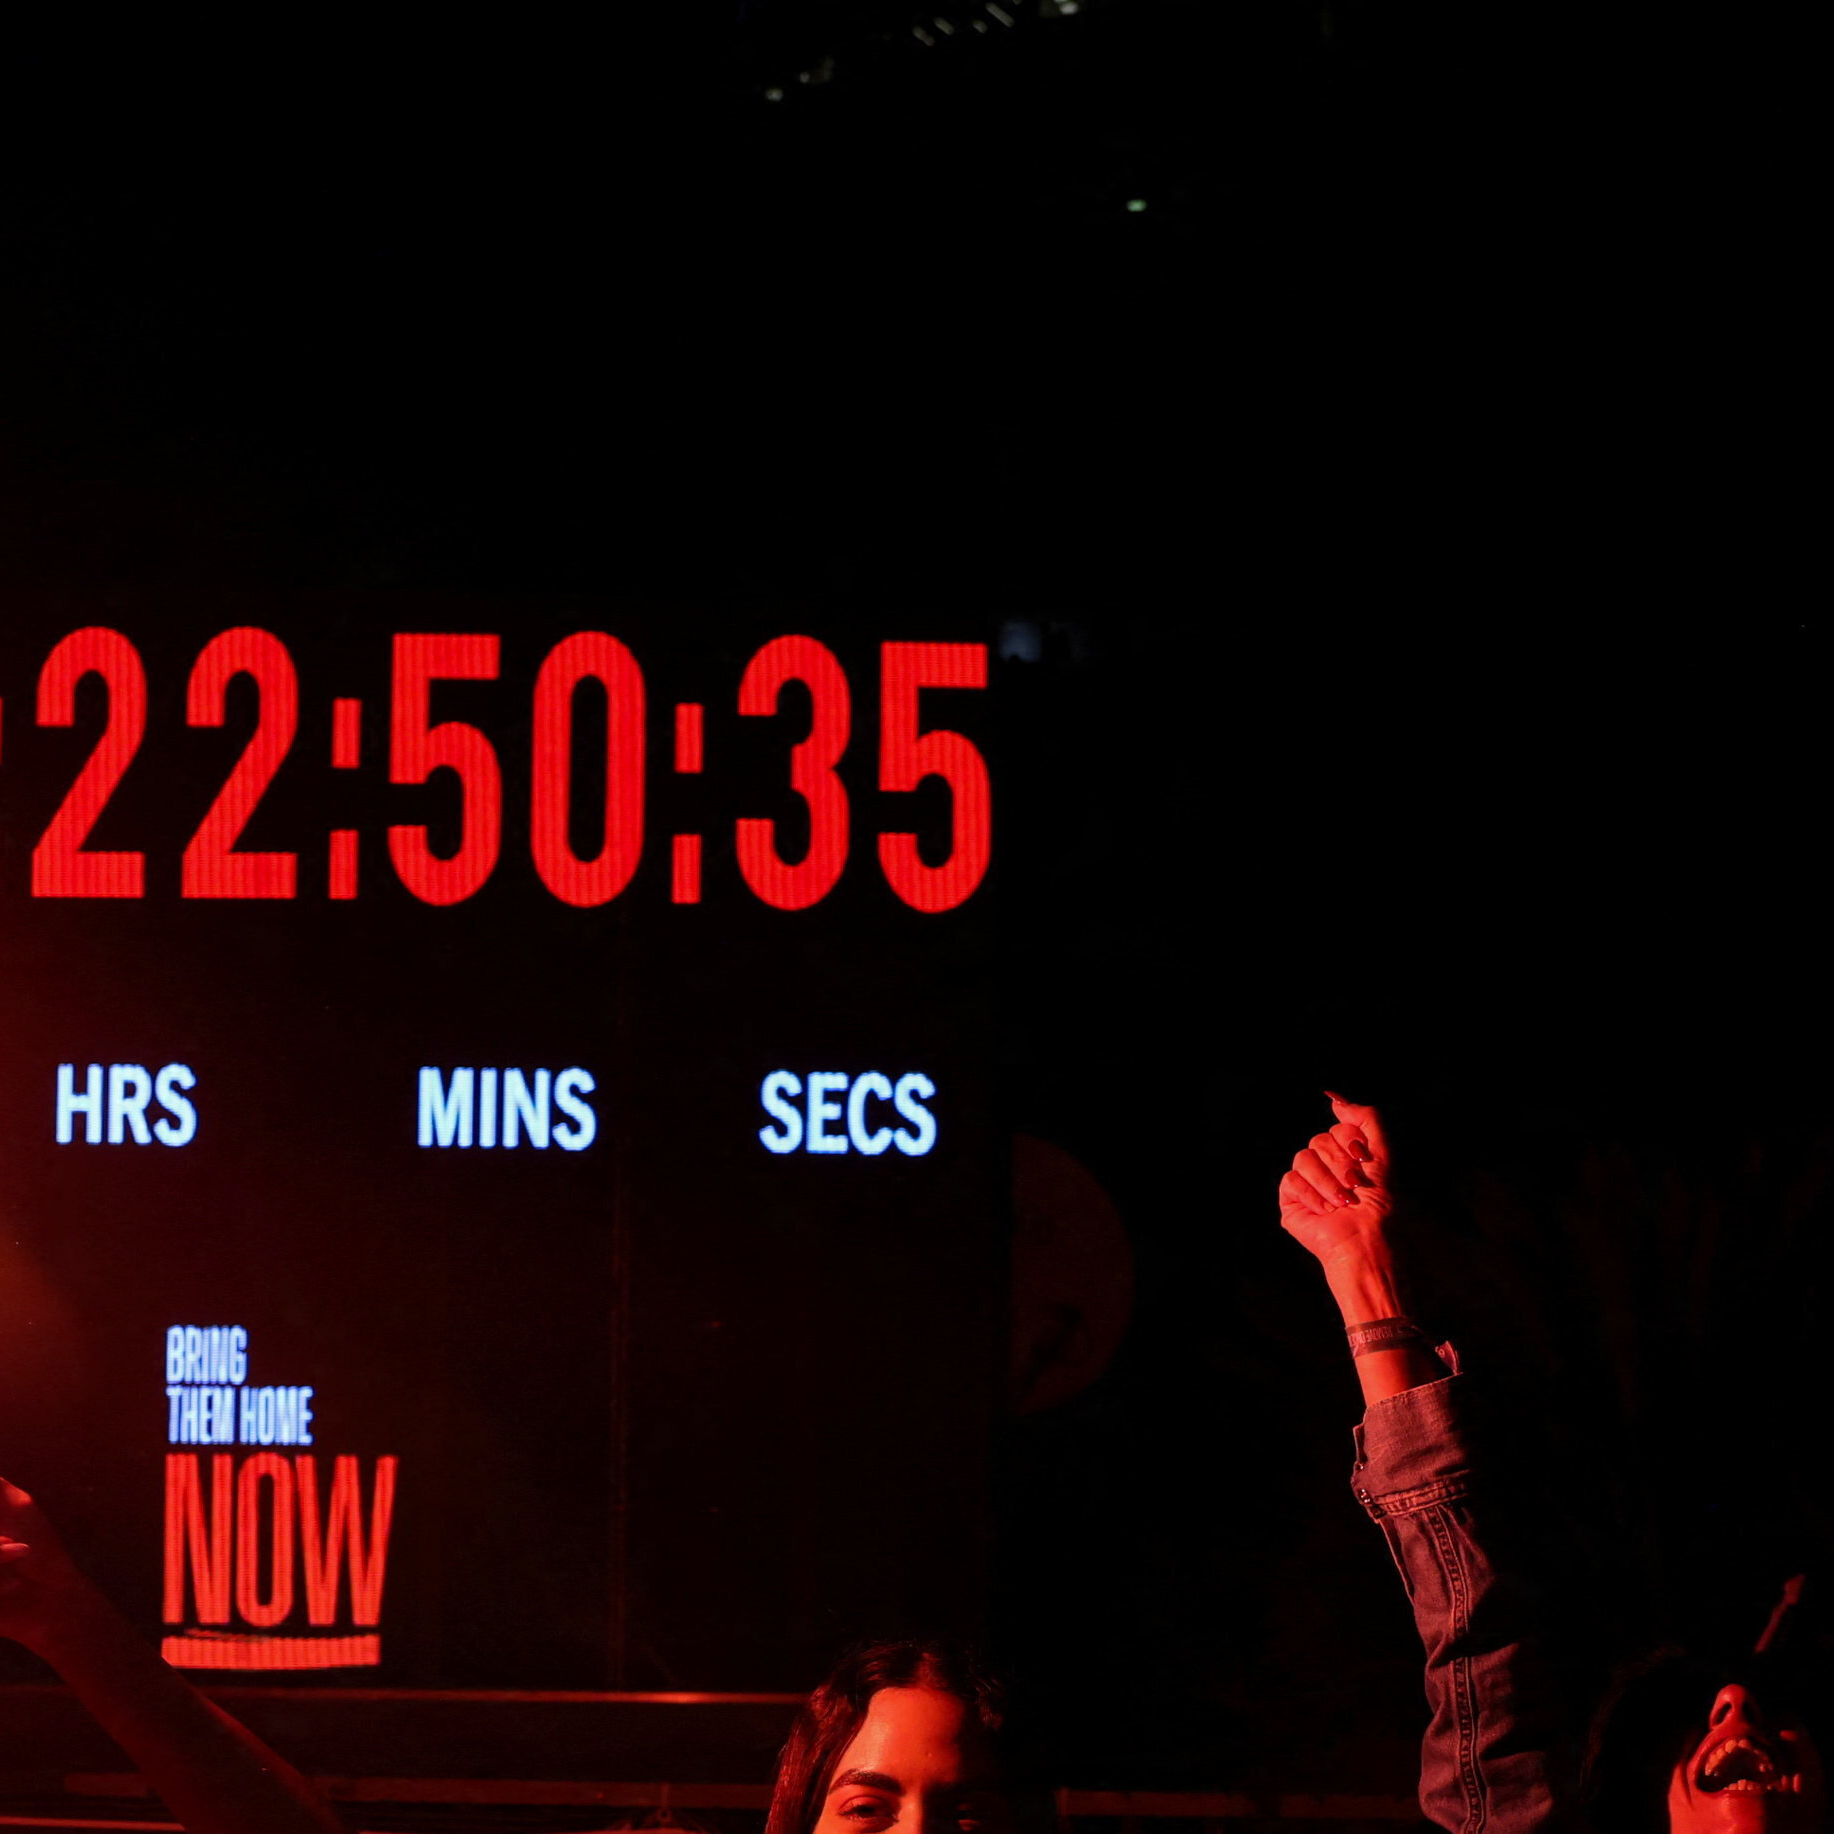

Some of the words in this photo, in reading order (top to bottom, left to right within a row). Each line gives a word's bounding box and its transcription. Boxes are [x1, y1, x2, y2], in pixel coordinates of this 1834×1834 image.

[55, 1062, 198, 1147] HRS
[417, 1066, 598, 1152] MINS
[758, 1070, 937, 1156] SECS
[166, 1324, 249, 1385] BRING
[165, 1385, 235, 1445] THEM
[238, 1385, 314, 1446] HOME
[163, 1452, 398, 1628] NOW
